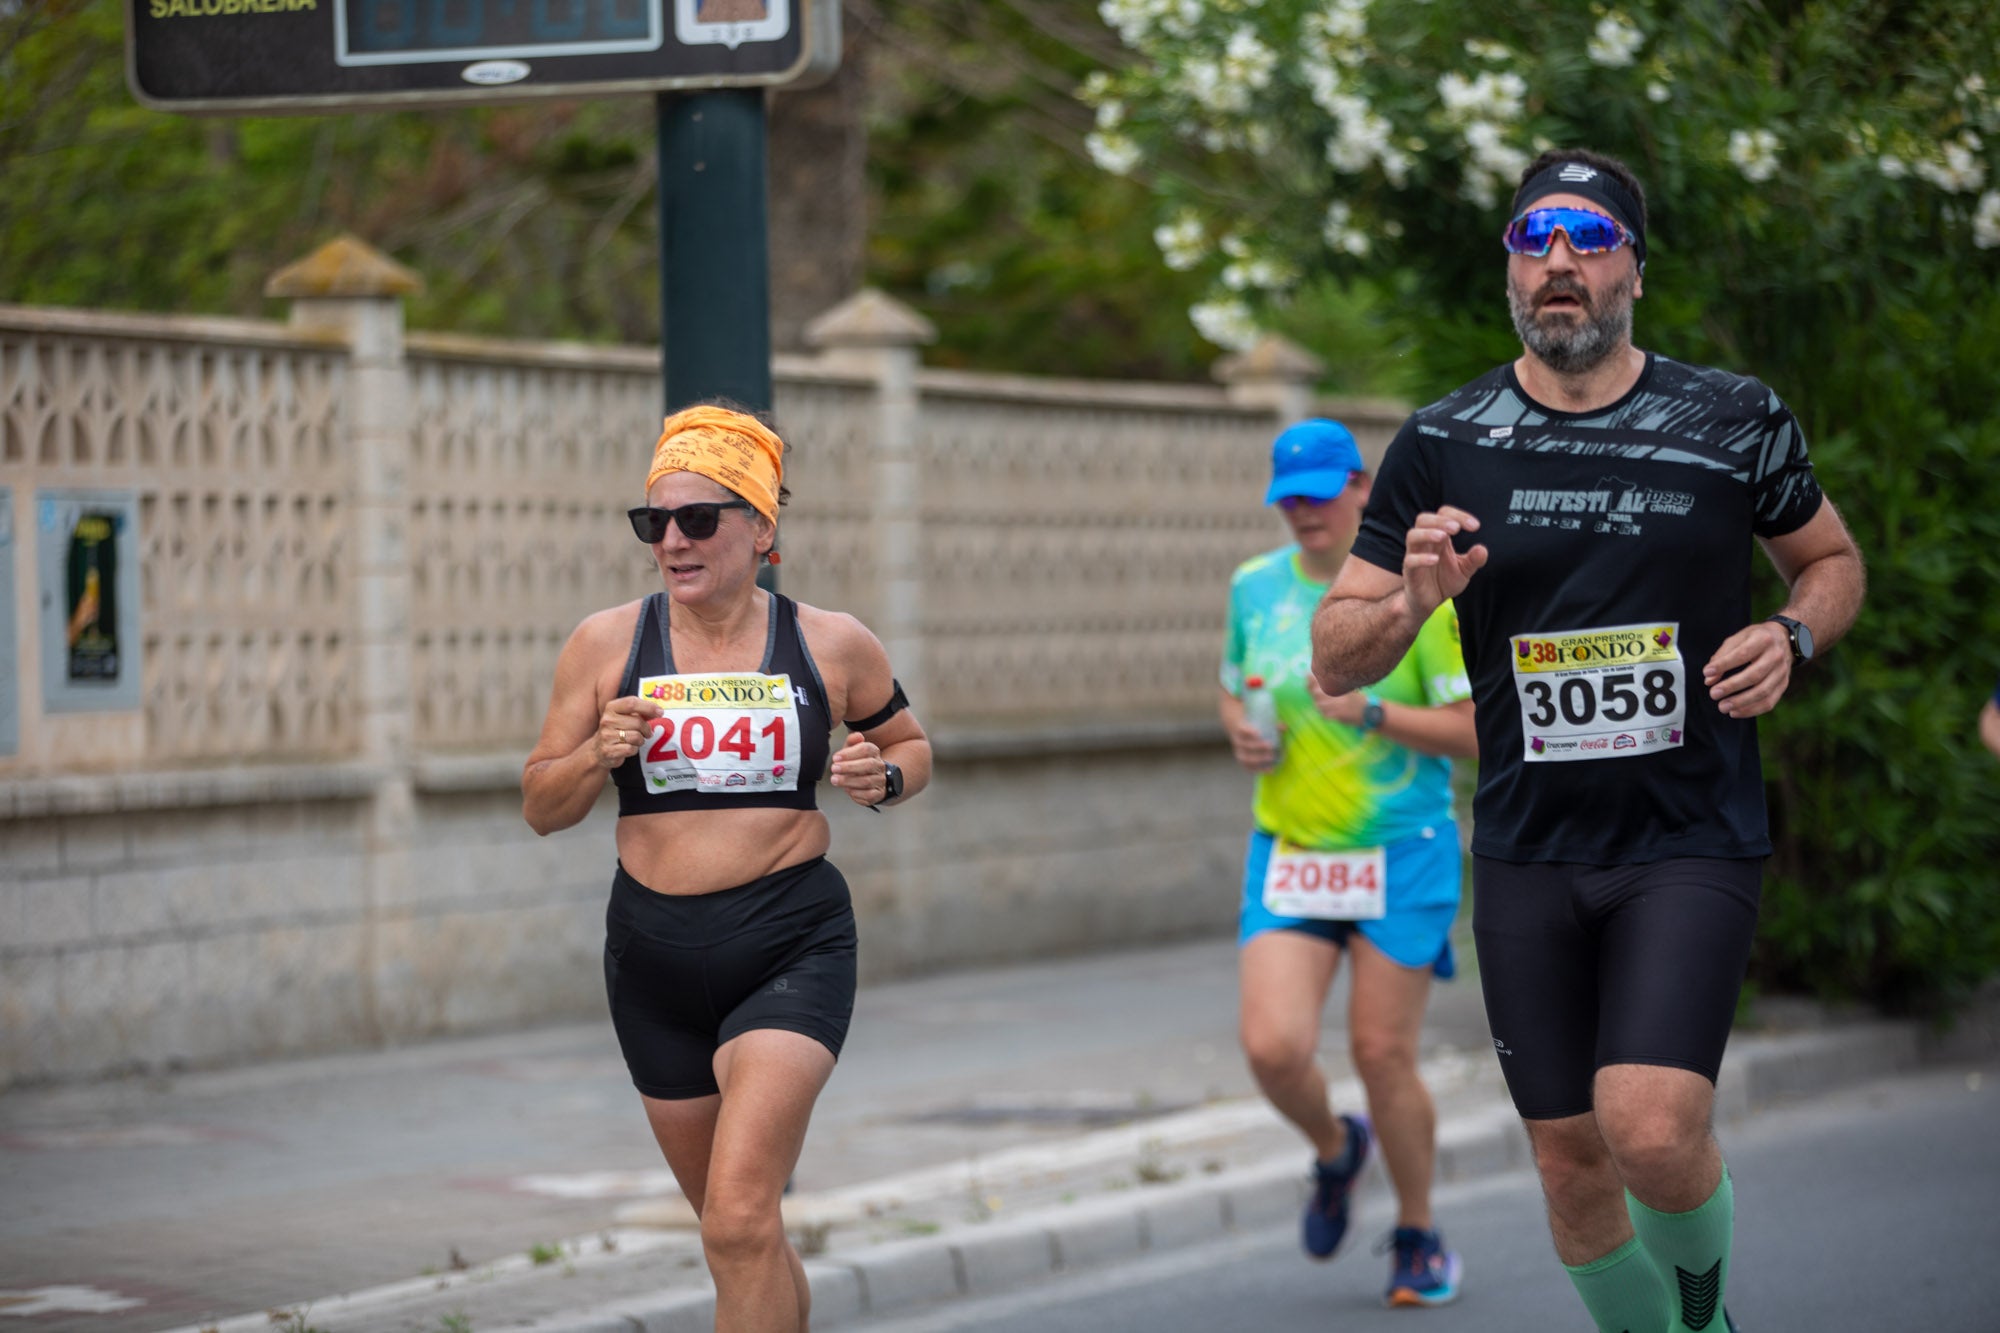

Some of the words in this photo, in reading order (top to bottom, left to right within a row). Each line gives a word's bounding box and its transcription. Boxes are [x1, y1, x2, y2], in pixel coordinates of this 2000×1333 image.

[1561, 636, 1591, 647] GRAN
[1595, 632, 1635, 643] PREMIO
[1533, 642, 1557, 664] 38
[1558, 640, 1645, 664] FONDO
[686, 687, 765, 702] FONDO
[690, 679, 720, 688] GRAN
[722, 679, 757, 688] PREMIO
[1524, 669, 1677, 727] 3058
[646, 716, 785, 763] 2041
[1274, 862, 1378, 894] 2084
